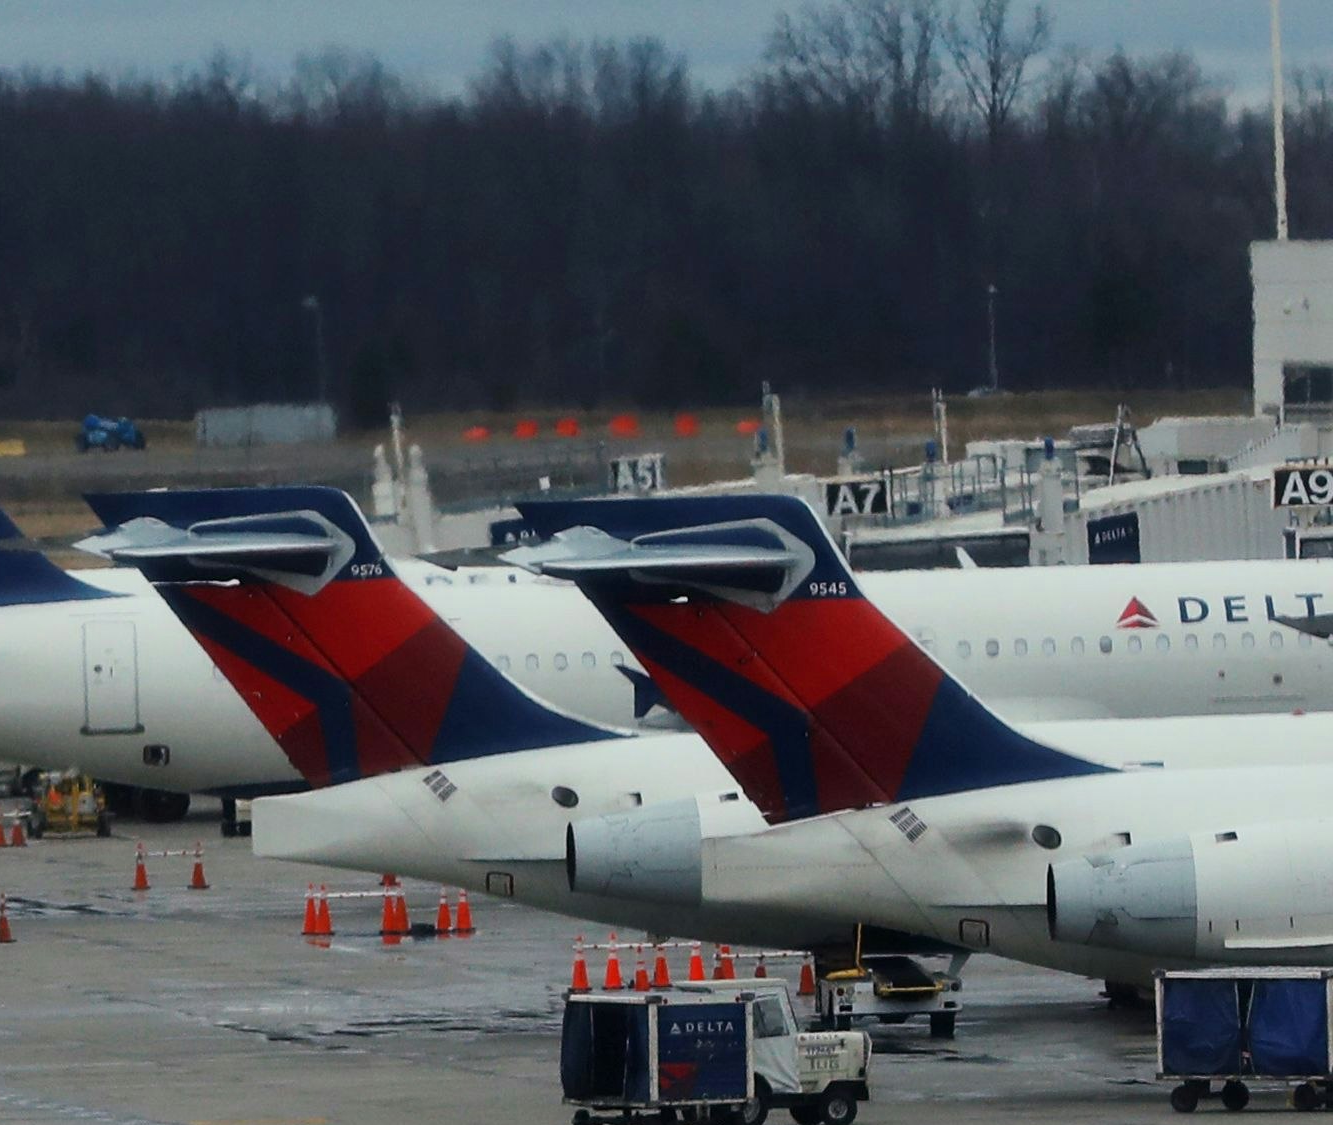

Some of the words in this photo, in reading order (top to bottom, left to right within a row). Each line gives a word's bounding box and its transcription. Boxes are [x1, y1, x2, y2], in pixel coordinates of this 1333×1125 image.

[1281, 470, 1333, 505] A9
[833, 483, 881, 514] A7
[351, 563, 383, 577] 9576
[809, 582, 847, 596] 9545
[685, 1021, 734, 1033] DELTA
